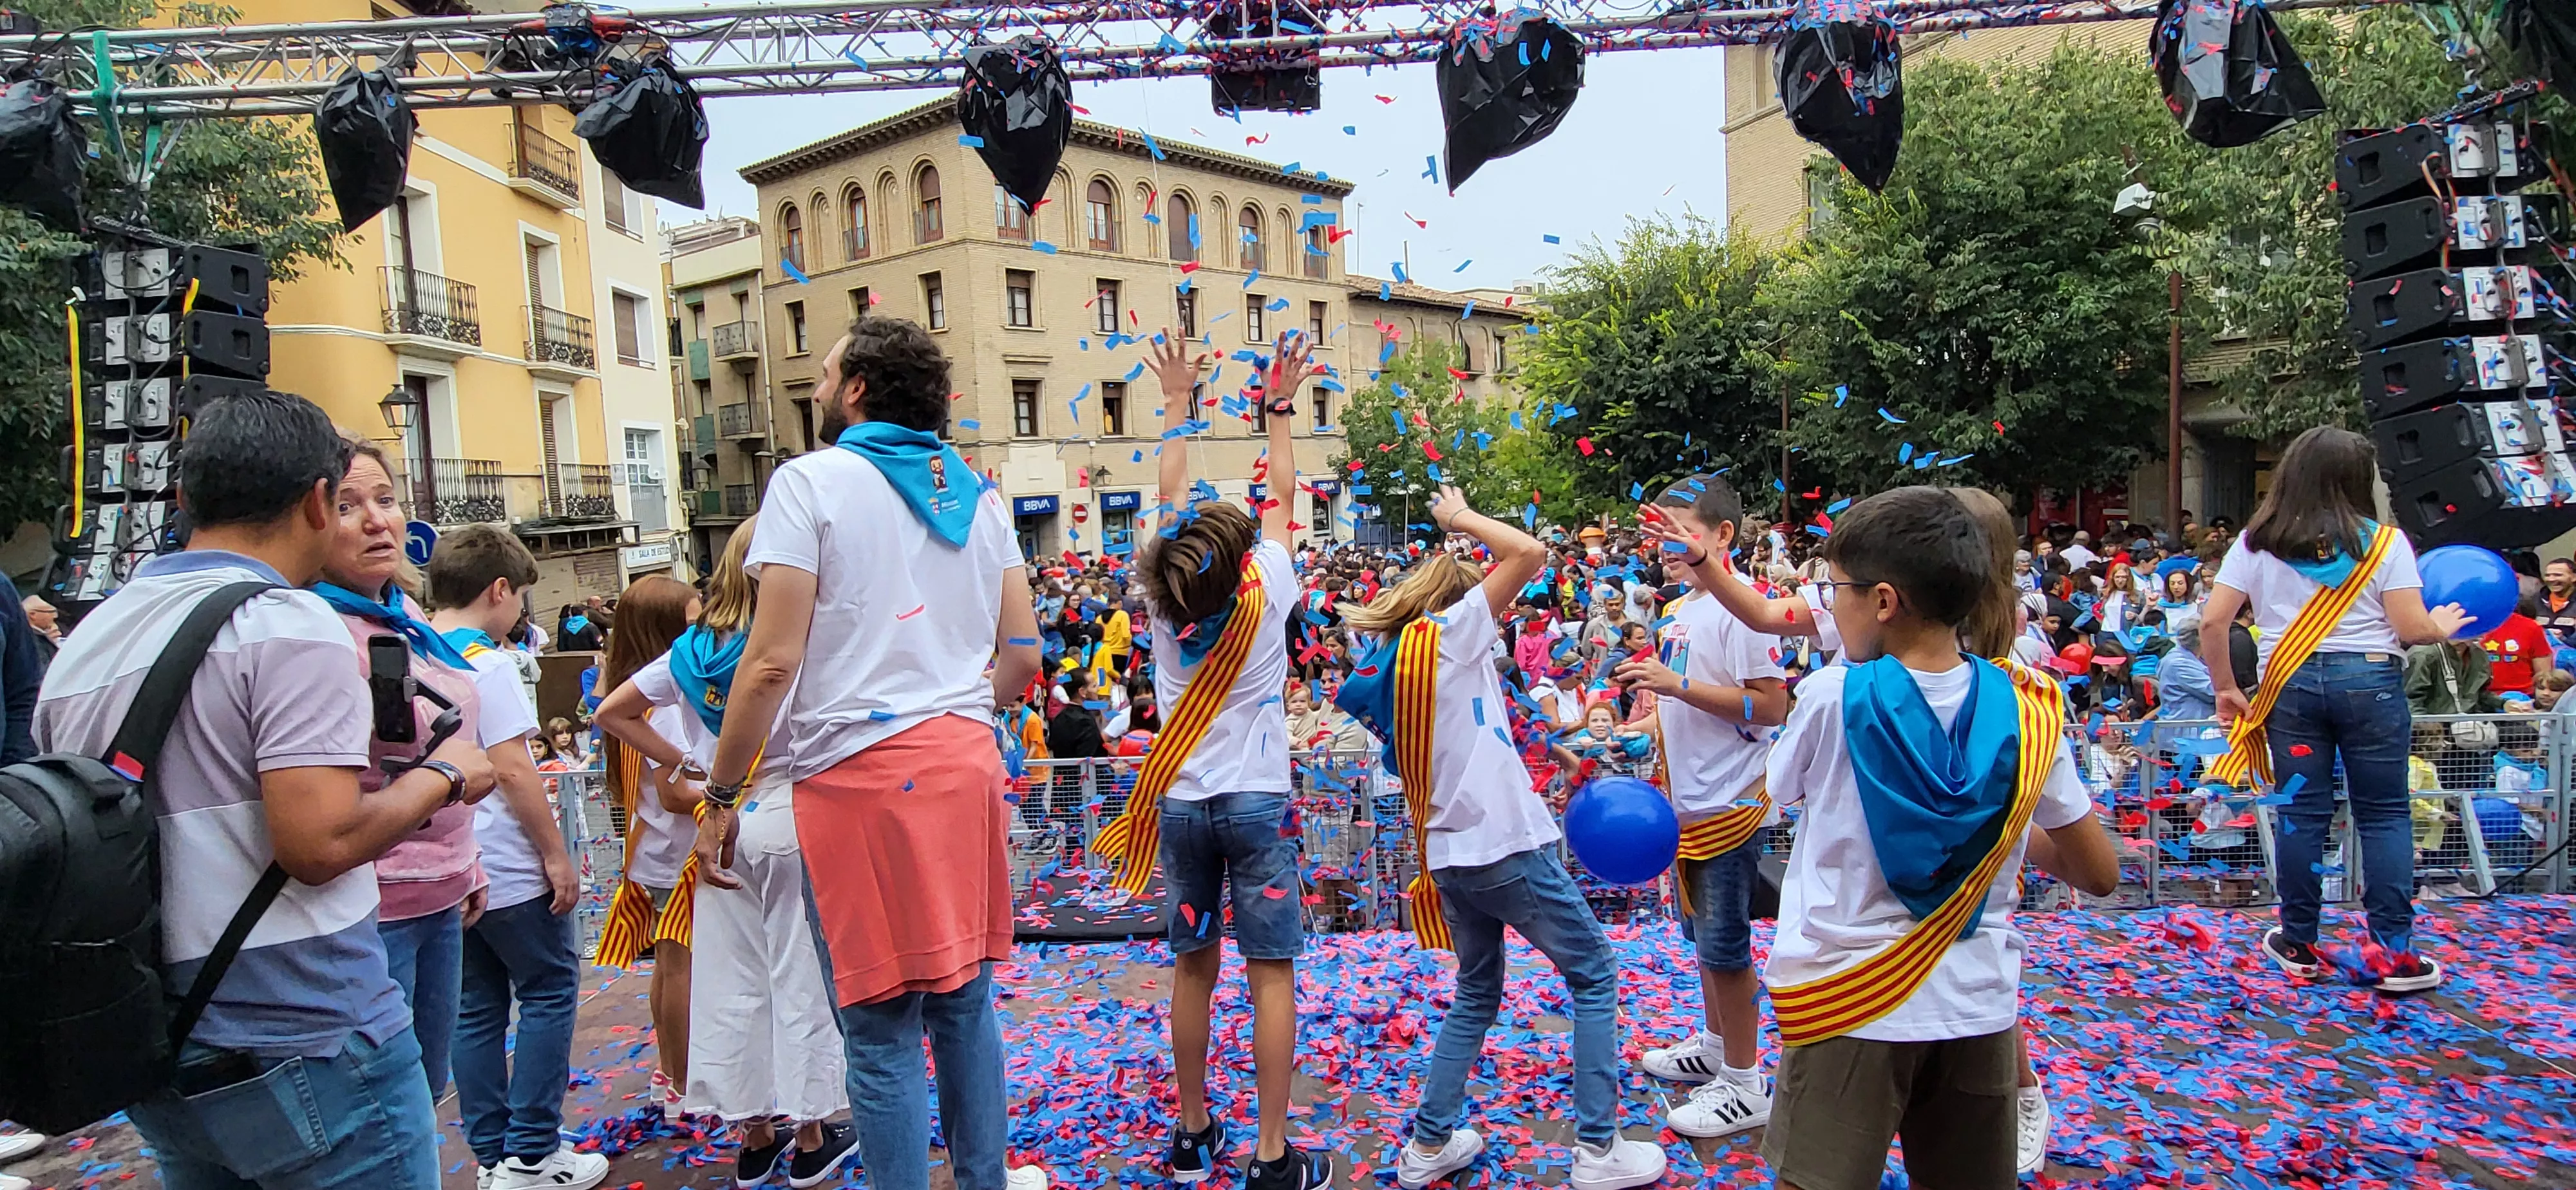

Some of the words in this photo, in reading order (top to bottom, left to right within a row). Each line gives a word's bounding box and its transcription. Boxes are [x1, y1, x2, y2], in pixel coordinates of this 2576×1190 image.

[1256, 487, 1266, 496] BB
[1023, 498, 1050, 511] BBVA
[1109, 495, 1133, 506] BBVA
[639, 549, 650, 558] SALA
[650, 547, 656, 556] DE
